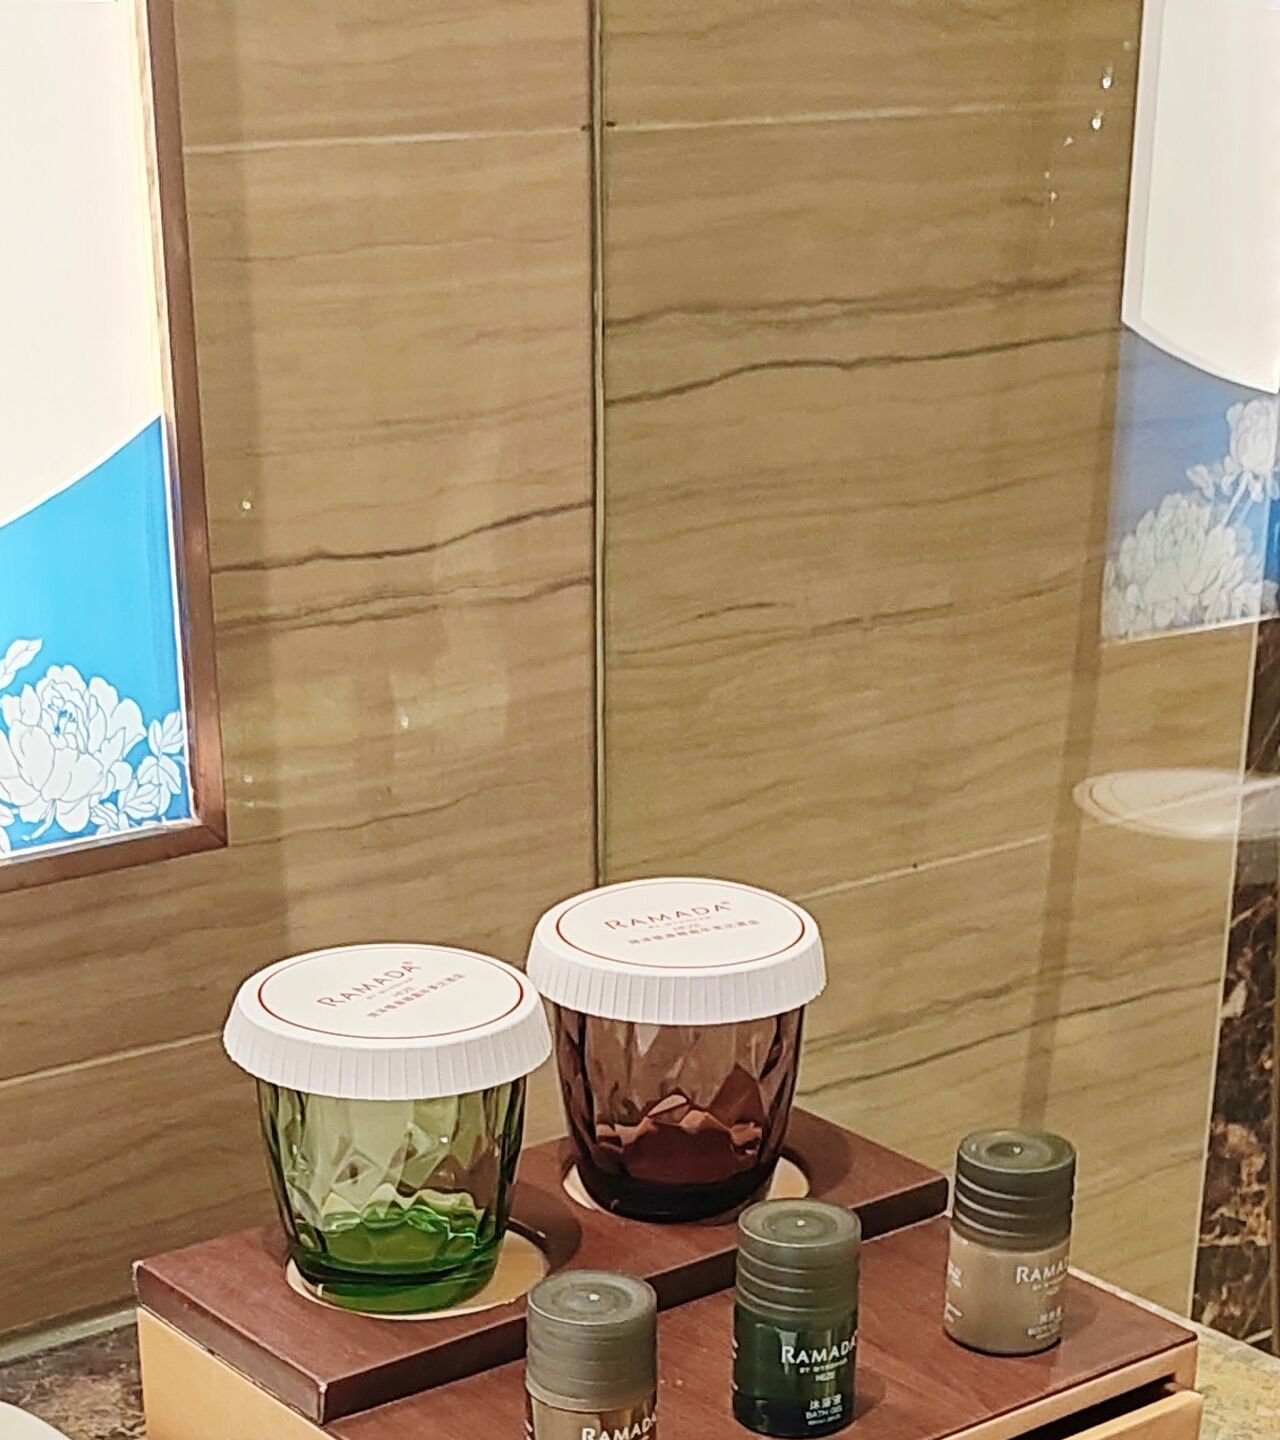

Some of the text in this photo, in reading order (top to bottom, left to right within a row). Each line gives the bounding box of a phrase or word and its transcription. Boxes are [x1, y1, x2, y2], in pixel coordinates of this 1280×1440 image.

[604, 903, 732, 931] RAMADA
[317, 963, 422, 1008] RAMADA
[1016, 1256, 1068, 1285] RAMA
